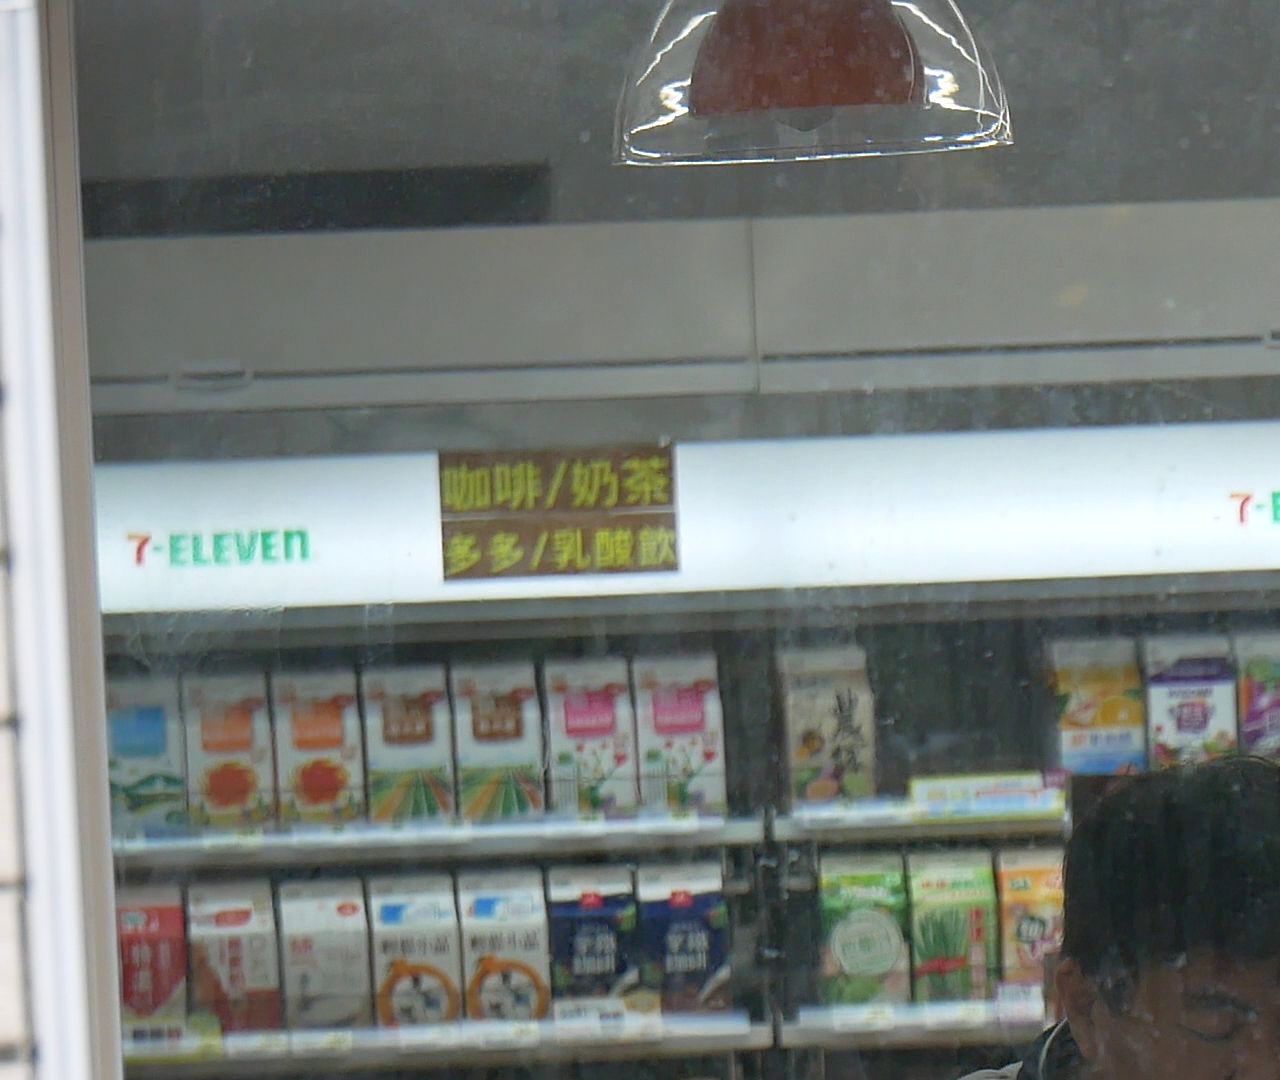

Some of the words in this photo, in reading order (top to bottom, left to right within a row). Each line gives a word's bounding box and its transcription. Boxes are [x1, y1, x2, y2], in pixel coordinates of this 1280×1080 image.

[442, 456, 671, 511] 咖啡/奶茶
[446, 525, 677, 576] 多多/乳酸飲
